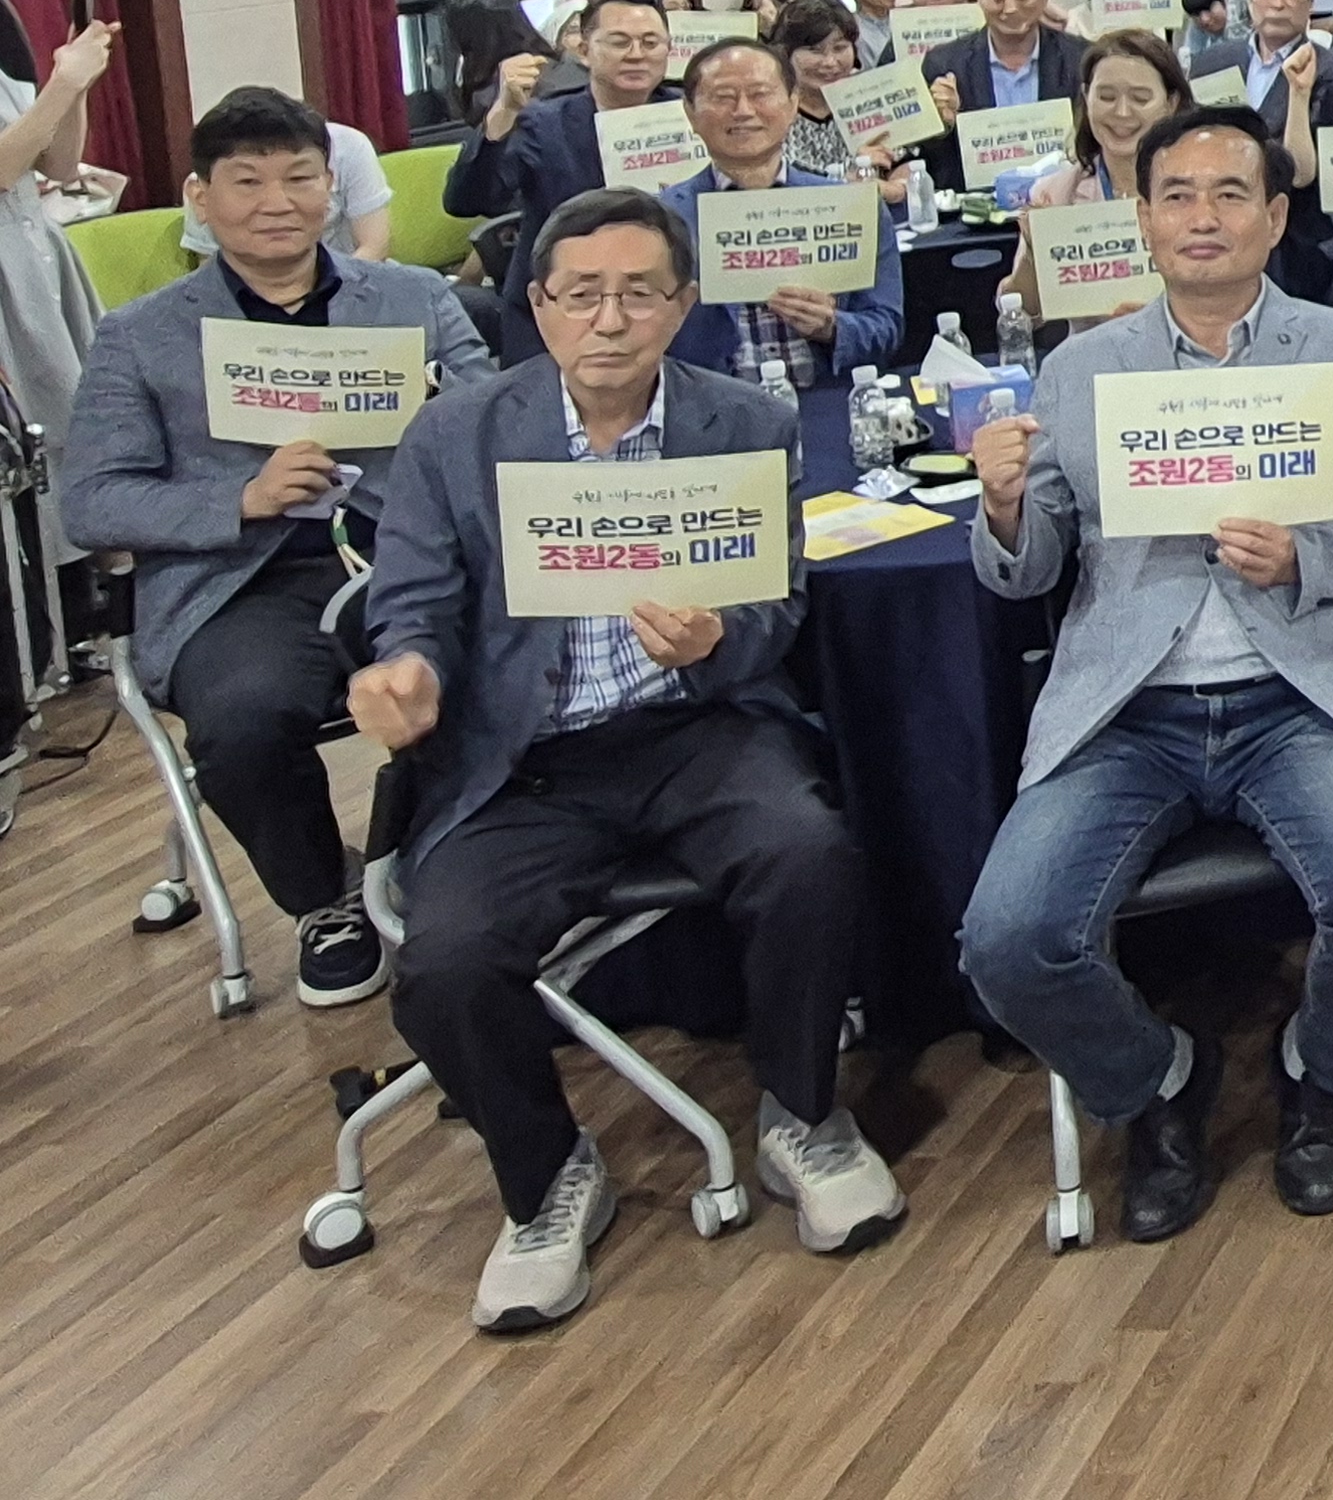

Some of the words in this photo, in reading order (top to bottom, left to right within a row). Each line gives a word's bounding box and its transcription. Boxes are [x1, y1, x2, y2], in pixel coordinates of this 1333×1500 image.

[716, 230, 752, 248] 우리
[756, 226, 808, 245] 손으로
[813, 222, 863, 241] 만드는
[722, 247, 813, 270] 조원2동의
[818, 241, 858, 263] 미래
[1050, 244, 1084, 262] 우리
[1088, 238, 1137, 259] 손으로
[223, 363, 264, 384] 우리
[270, 368, 332, 387] 손으로
[338, 369, 406, 388] 만드는
[345, 391, 398, 412] 미래
[1120, 429, 1167, 453] 우리
[1174, 426, 1245, 450] 손으로
[1252, 421, 1322, 445] 만드는
[1129, 455, 1252, 487] 조원2동의
[1259, 448, 1316, 478] 미래
[528, 517, 583, 539] 우리
[591, 515, 673, 538] 손으로
[681, 506, 763, 533] 만드는
[538, 543, 681, 570] 조원2동의
[688, 532, 755, 564] 미래
